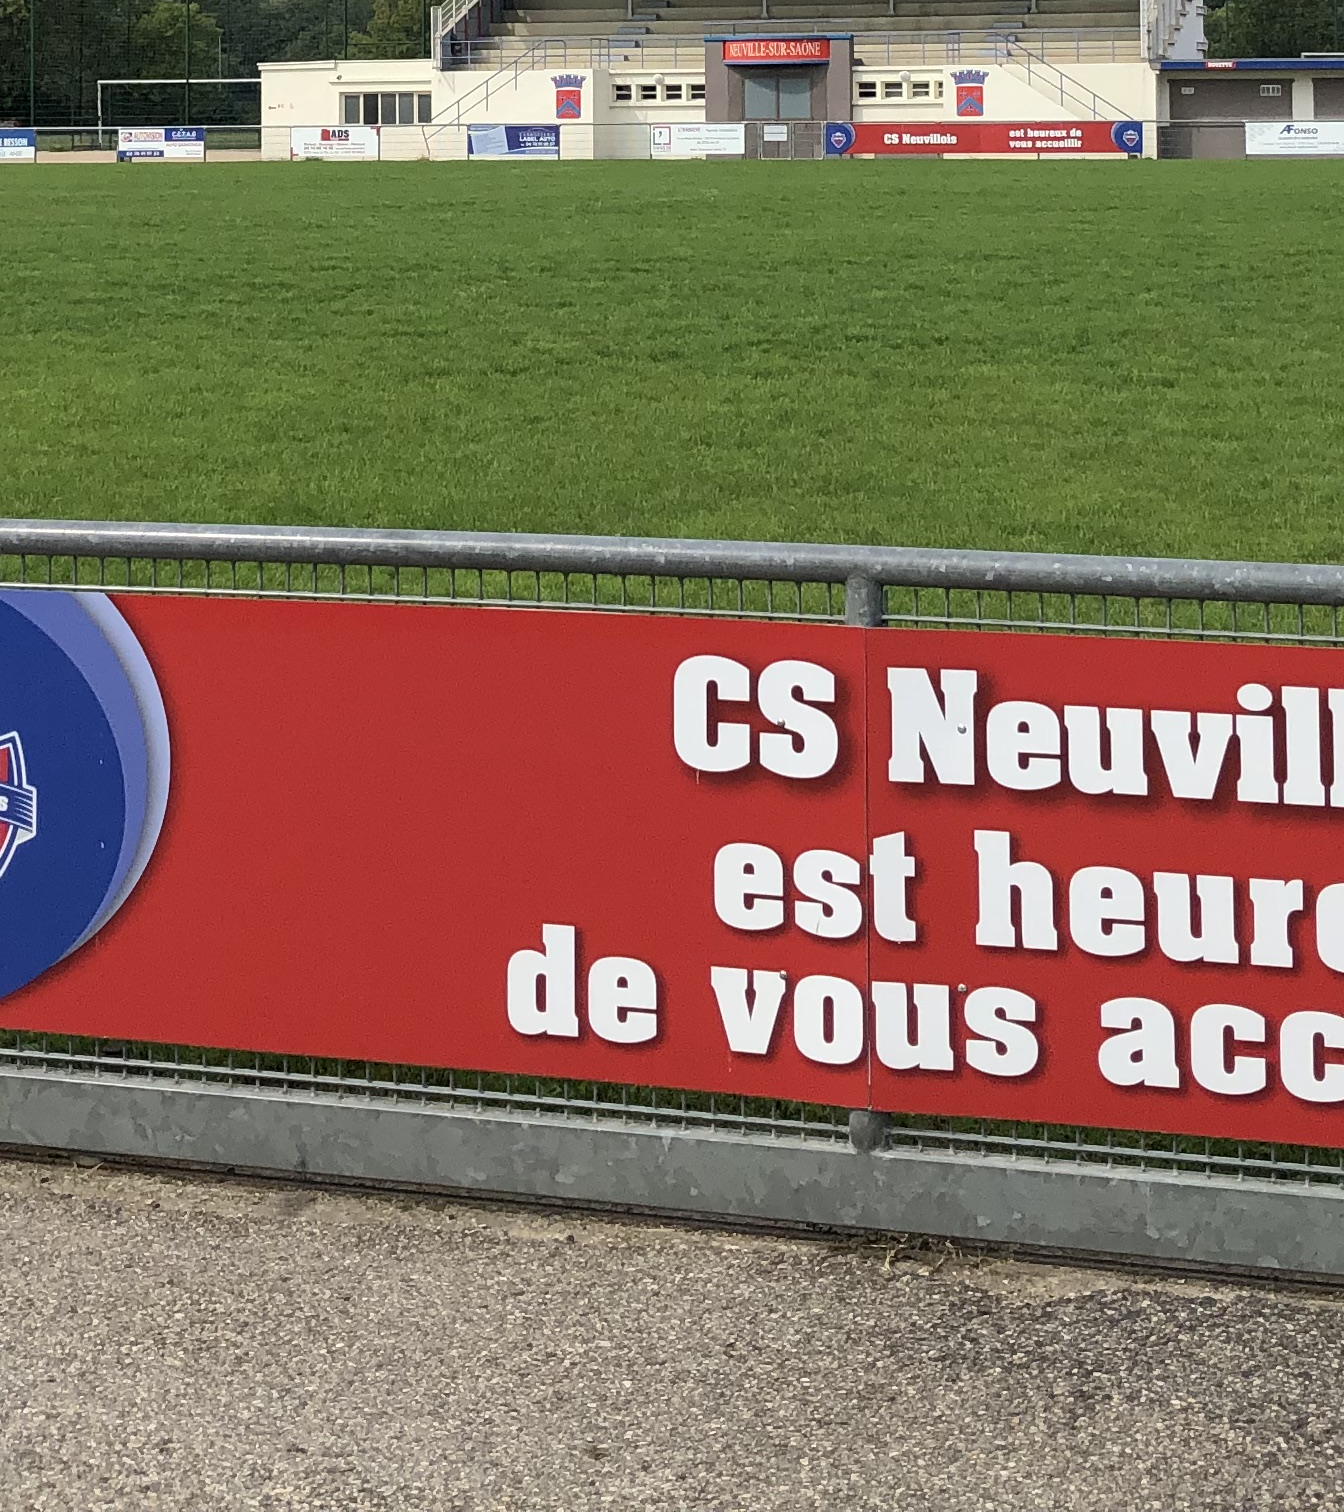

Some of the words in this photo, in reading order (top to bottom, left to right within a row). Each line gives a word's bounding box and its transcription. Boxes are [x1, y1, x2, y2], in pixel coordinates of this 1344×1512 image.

[729, 40, 821, 56] NEUVILLE-SUR-SAÔNE
[330, 129, 349, 138] ADS
[884, 133, 899, 144] CS
[902, 133, 957, 144] Neuvillois
[1009, 129, 1024, 137] est
[1027, 128, 1067, 137] heureux
[1070, 128, 1082, 137] de
[1009, 140, 1032, 148] vous
[1035, 138, 1082, 148] accueillir
[674, 655, 839, 779] CS
[714, 831, 917, 942] est
[507, 924, 657, 1044] de
[711, 966, 1039, 1077] vous
